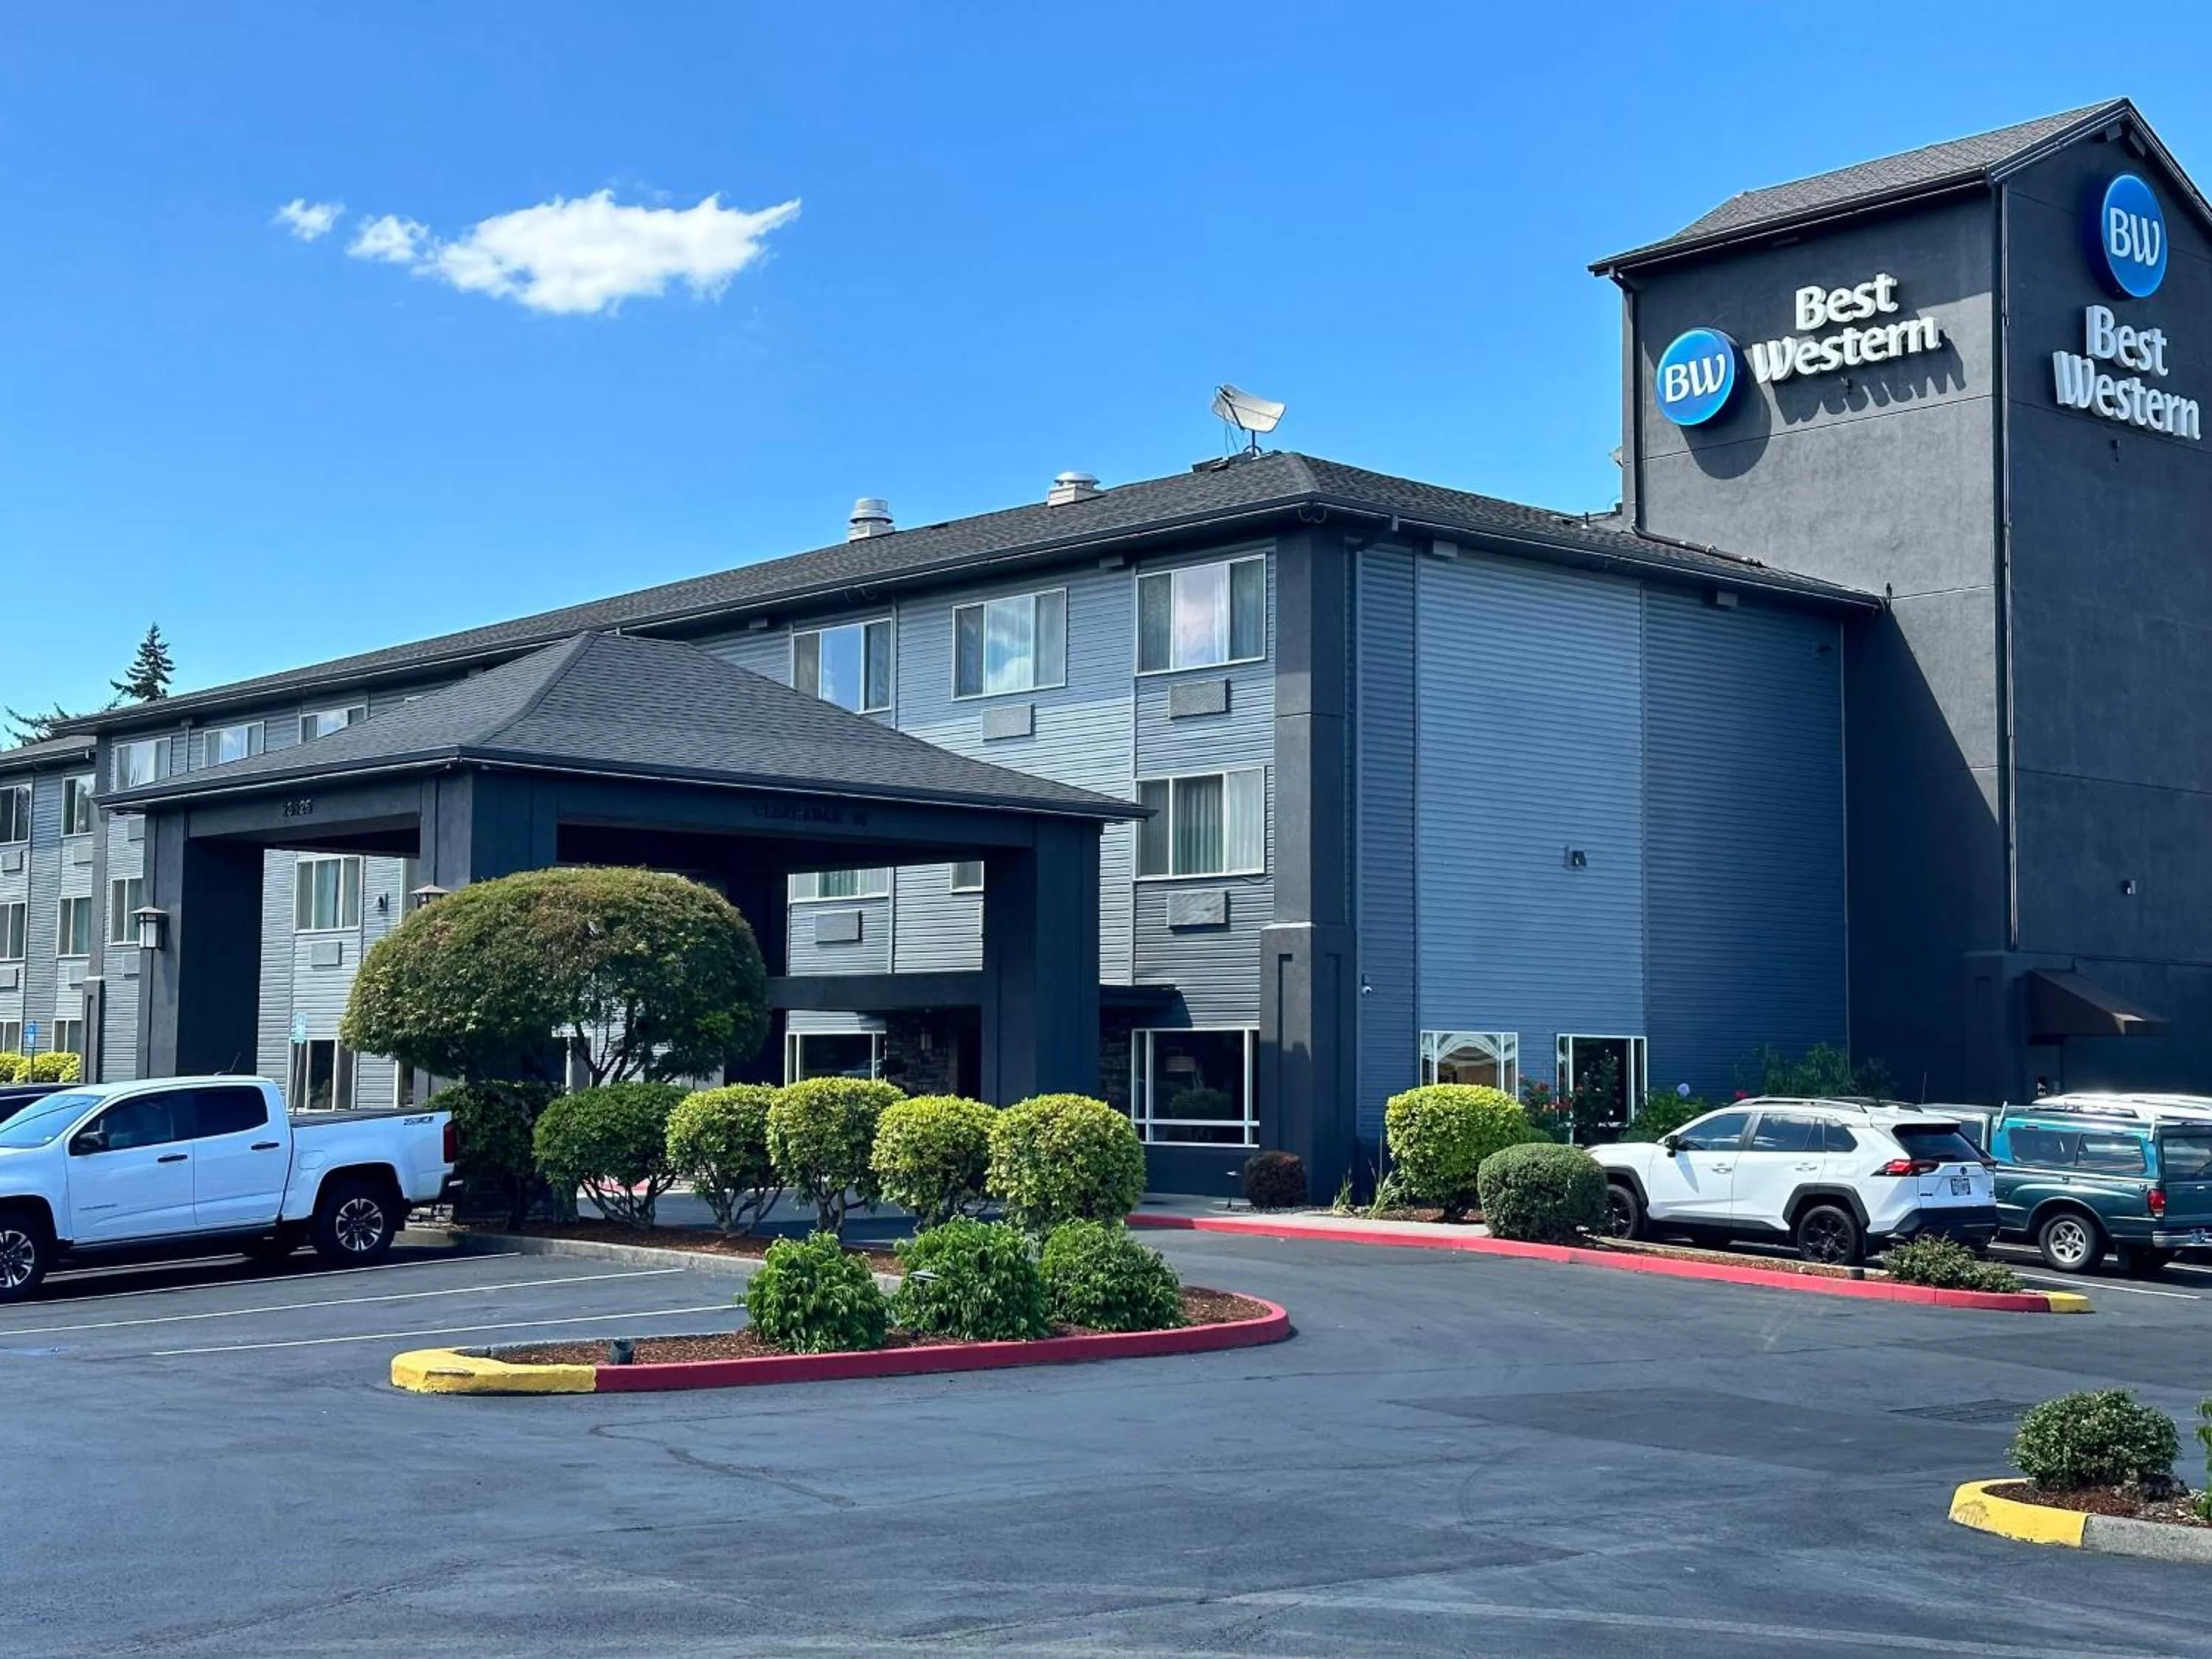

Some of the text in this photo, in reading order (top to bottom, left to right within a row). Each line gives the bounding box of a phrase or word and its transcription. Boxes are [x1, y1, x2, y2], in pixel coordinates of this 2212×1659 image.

[2110, 206, 2160, 266] BW
[1795, 272, 1899, 331] Best
[1751, 316, 1943, 384] Western
[2086, 305, 2168, 377] Best
[1665, 353, 1726, 403] BW
[2053, 350, 2202, 440] Western
